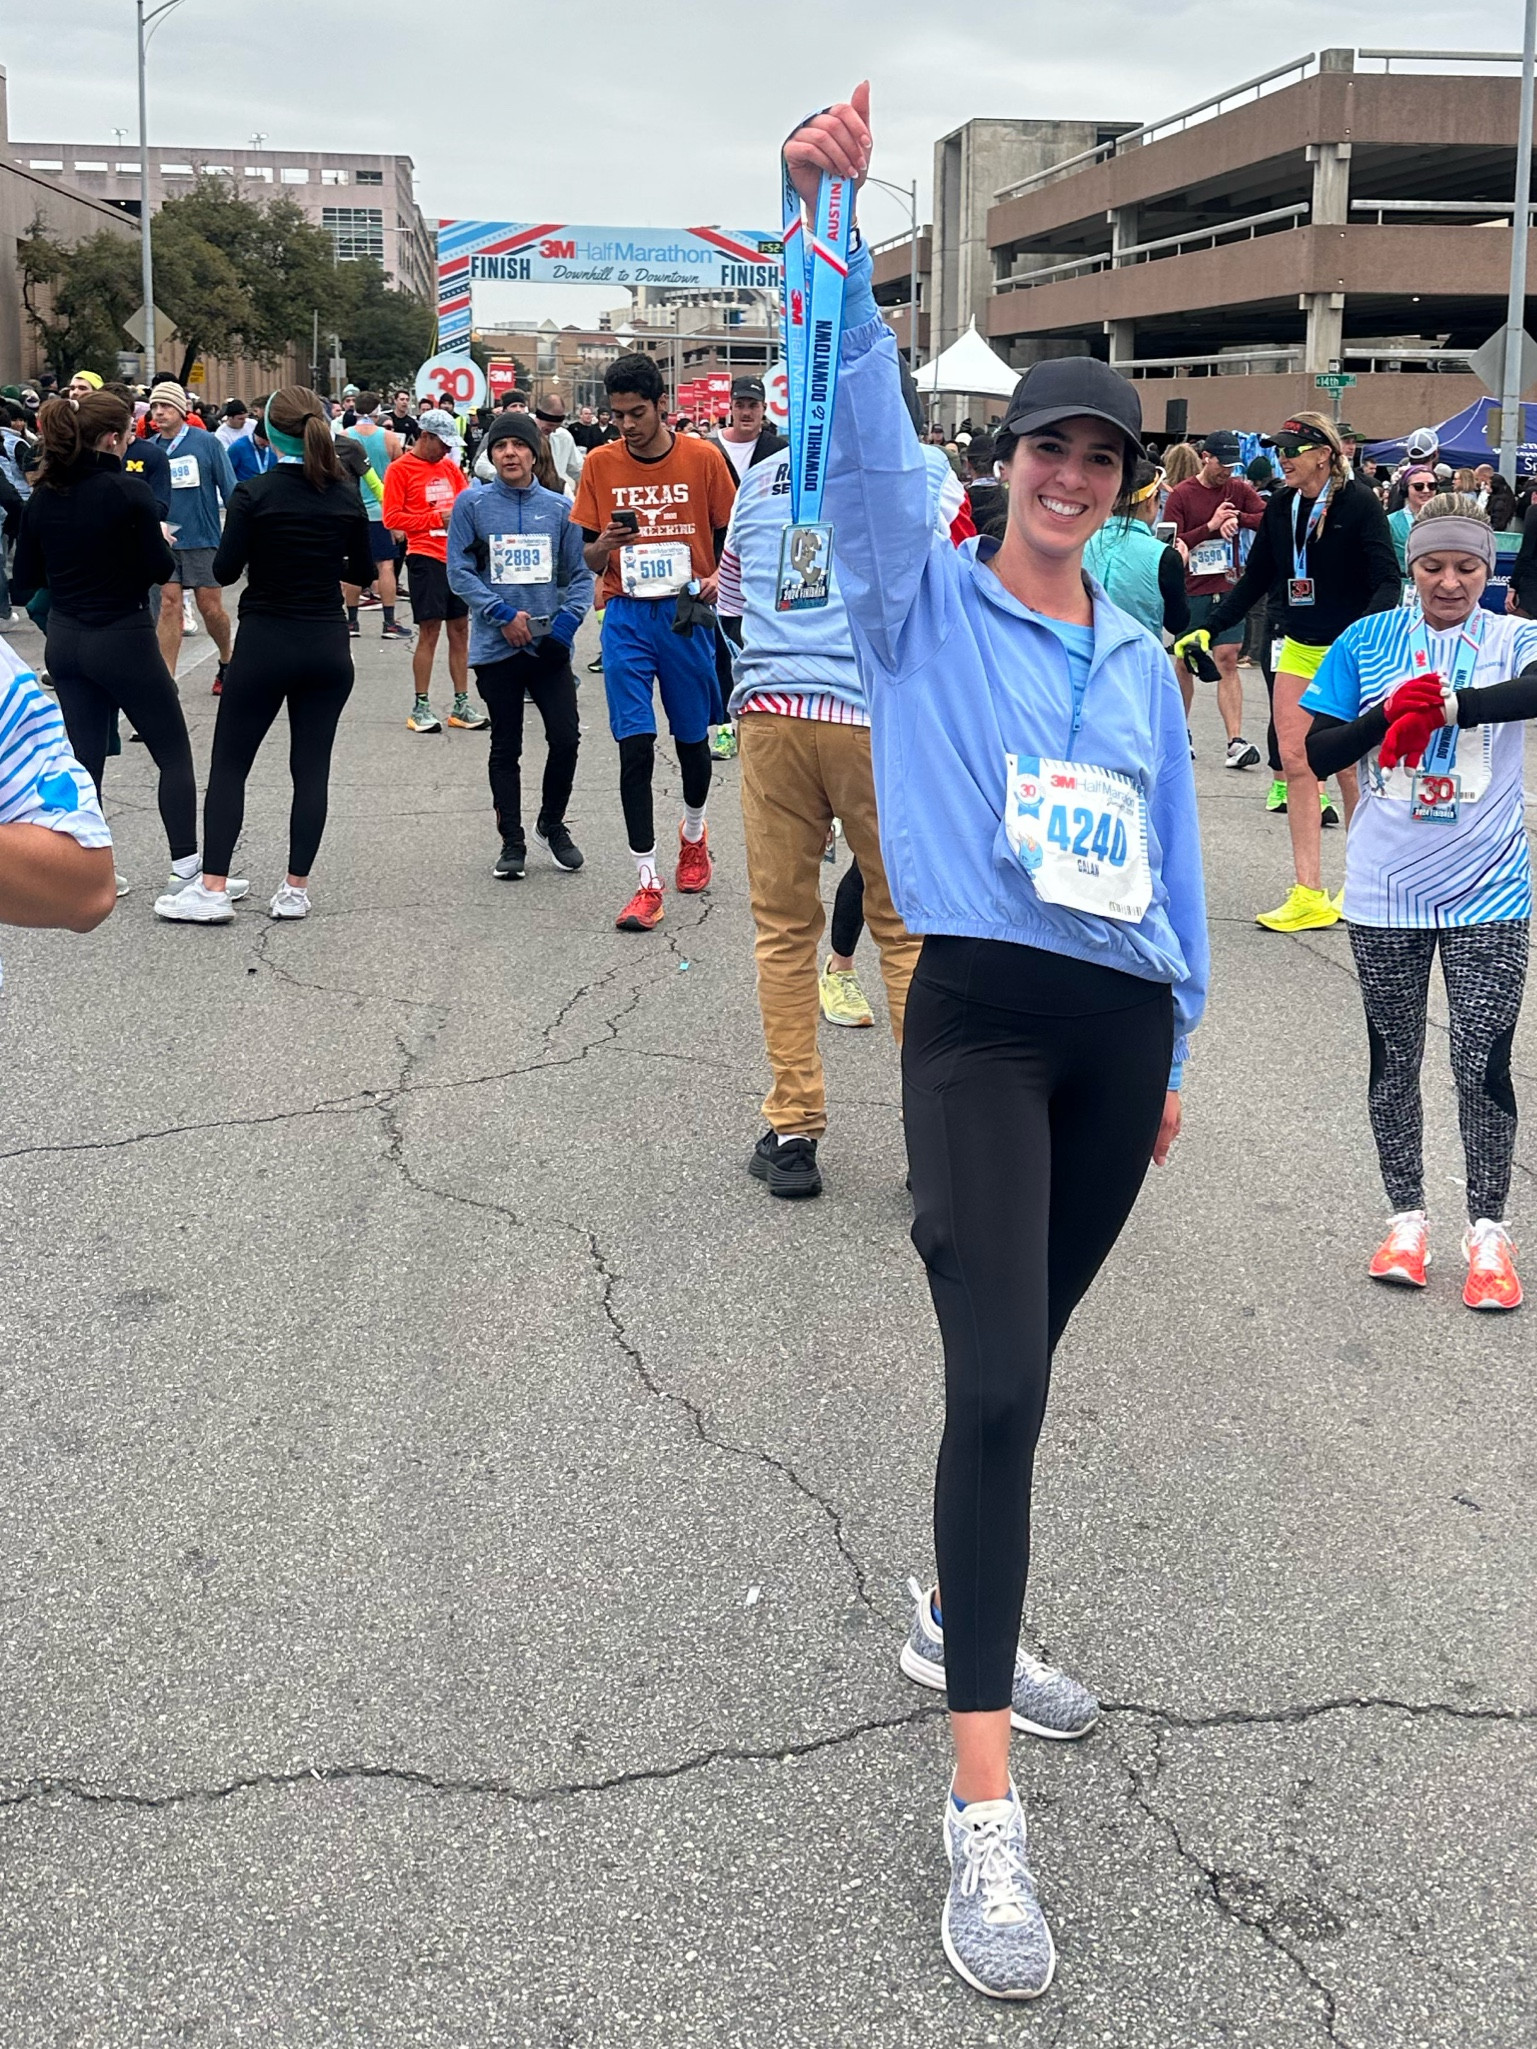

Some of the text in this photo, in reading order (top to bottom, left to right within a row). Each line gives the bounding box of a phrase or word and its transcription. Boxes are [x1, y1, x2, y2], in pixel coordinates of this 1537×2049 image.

[826, 183, 842, 241] AUSTIN
[539, 239, 576, 259] 3M
[471, 256, 531, 280] FINISH
[553, 265, 700, 284] Downhill to Downtown
[721, 265, 779, 287] FINISH
[790, 288, 804, 326] 3M
[490, 370, 512, 383] 3M
[708, 380, 730, 391] 3M
[1321, 377, 1339, 386] 14th
[770, 375, 788, 416] 3
[804, 320, 833, 492] DOWNHILL to DOWNTOWN
[125, 460, 144, 472] M
[612, 484, 689, 506] TEXAS
[771, 483, 791, 495] SE
[638, 523, 696, 537] NEERING
[505, 549, 540, 566] 2883
[640, 559, 673, 579] 5181
[1415, 649, 1427, 668] 3M
[1019, 783, 1037, 798] 30
[1051, 775, 1075, 790] 3M
[1418, 776, 1455, 806] 30
[1047, 804, 1128, 867] 4240
